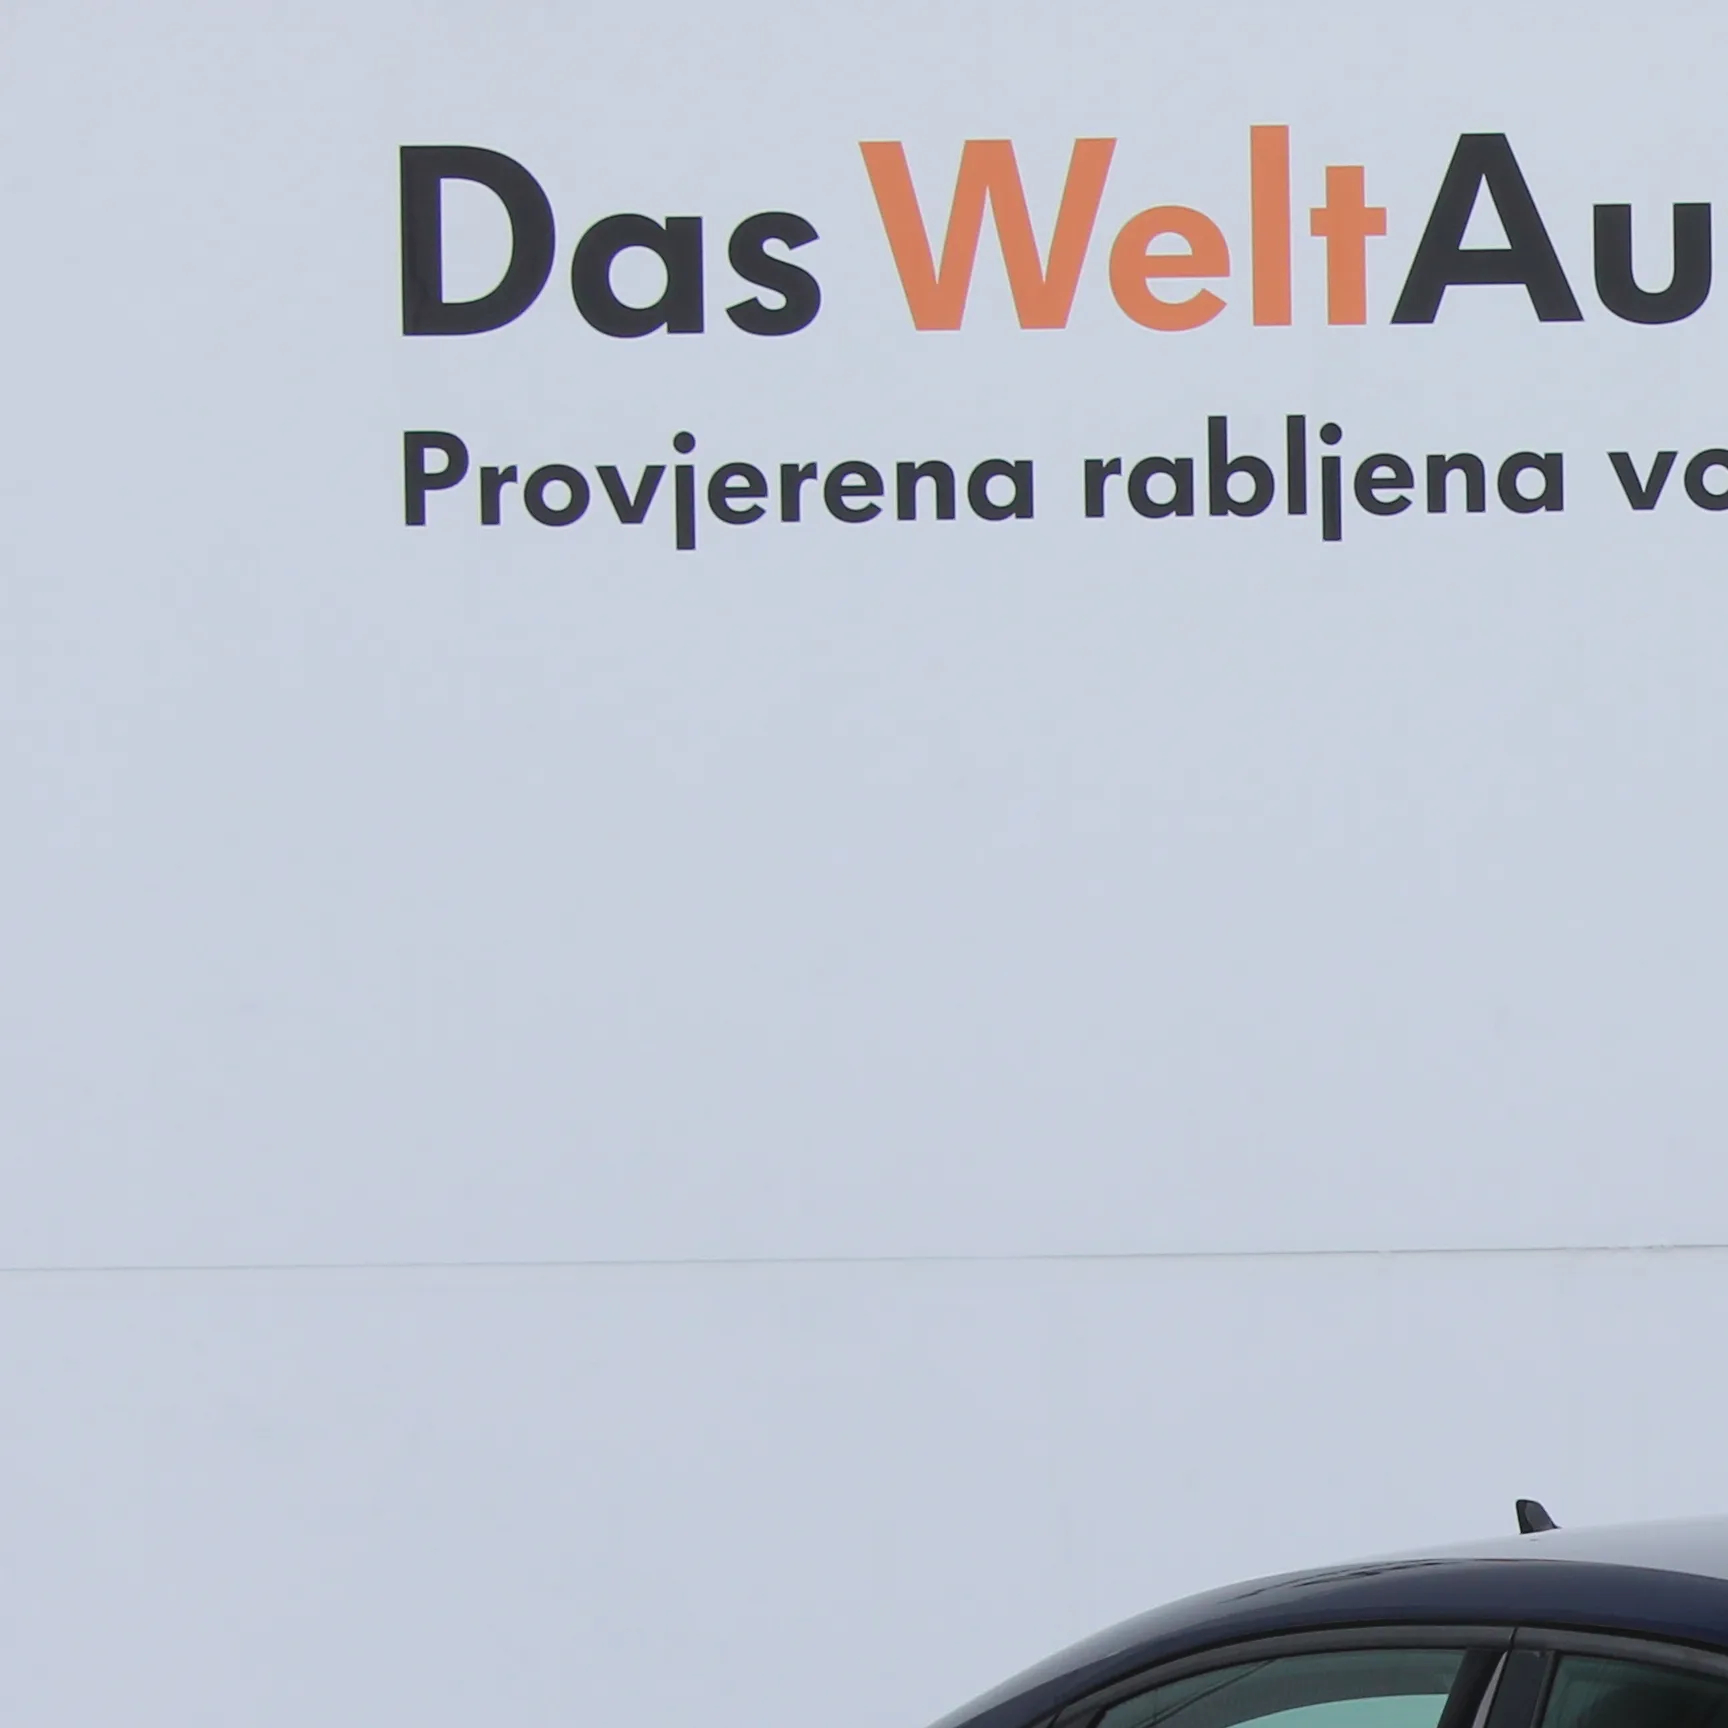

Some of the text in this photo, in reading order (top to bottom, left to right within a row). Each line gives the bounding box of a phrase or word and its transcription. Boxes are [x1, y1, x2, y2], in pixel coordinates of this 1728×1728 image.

[400, 145, 821, 338] Das
[404, 431, 1034, 550] Provjerena
[1084, 415, 1564, 541] rabljena
